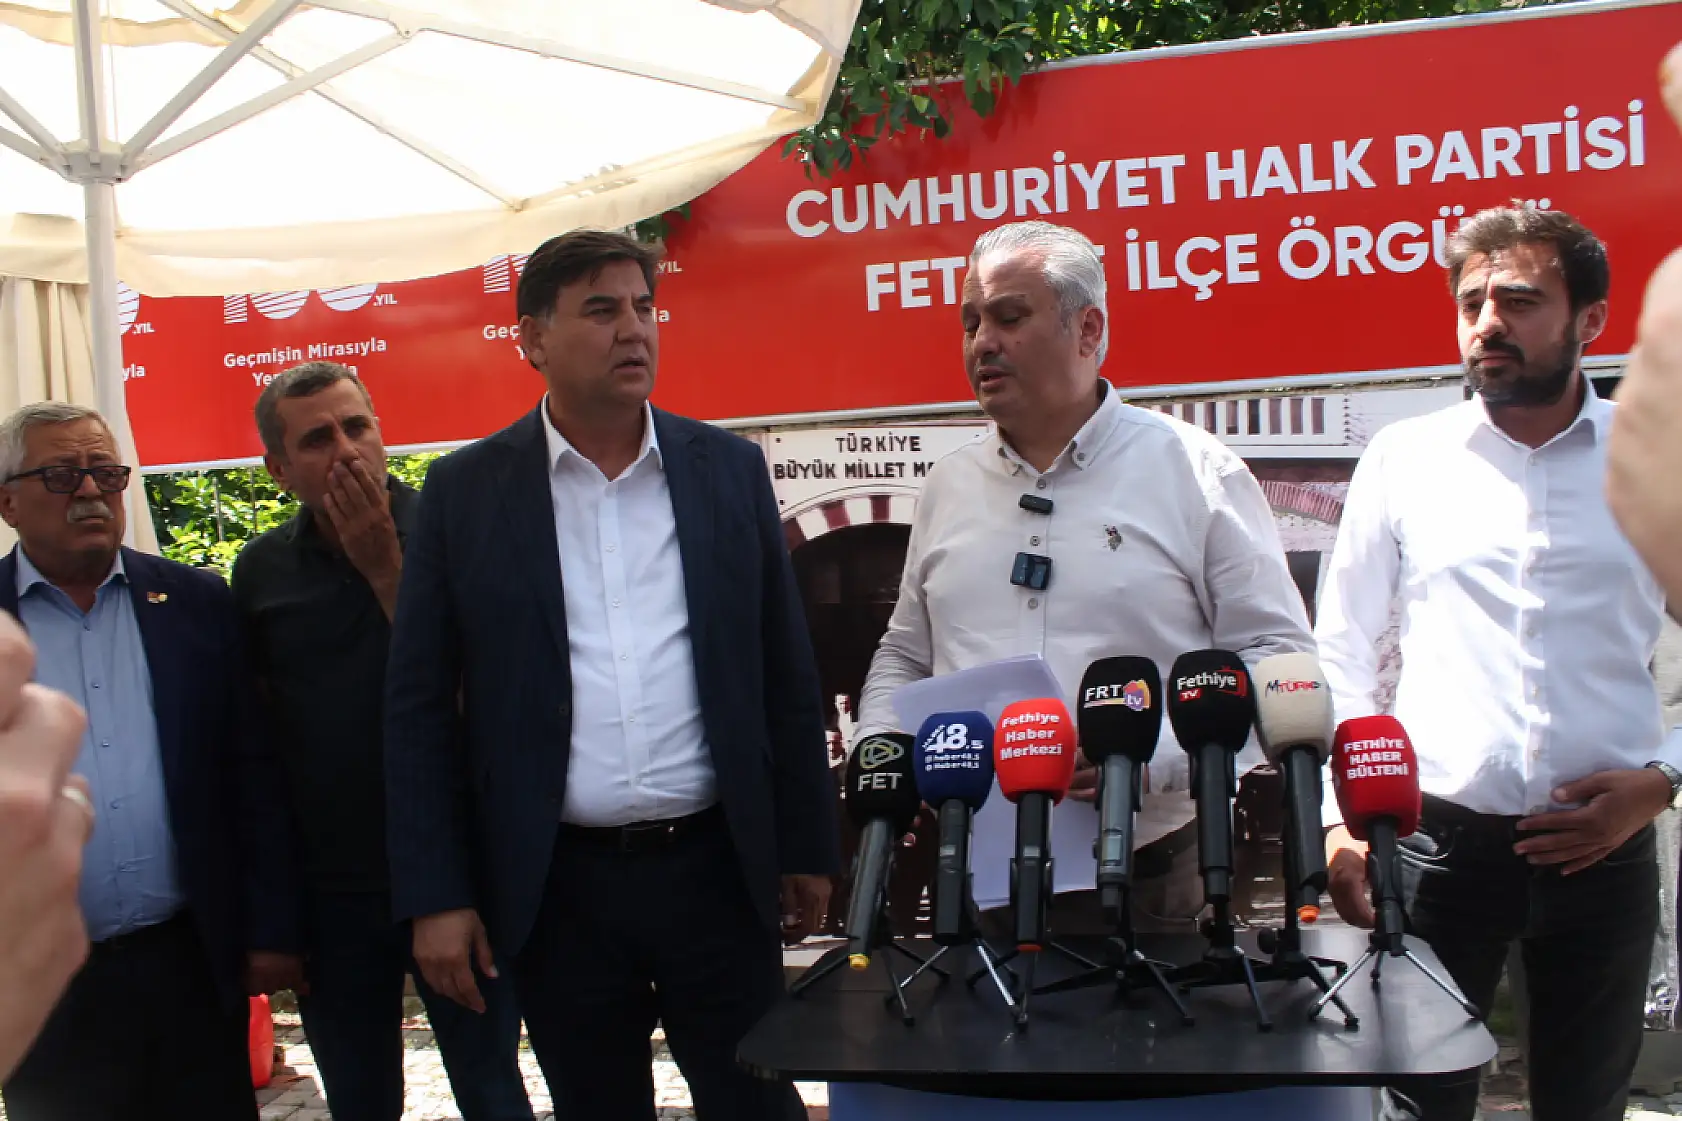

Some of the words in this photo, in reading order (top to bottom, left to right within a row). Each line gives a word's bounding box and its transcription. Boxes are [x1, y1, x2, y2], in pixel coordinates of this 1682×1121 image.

[786, 150, 1185, 238] CUMHURİYET
[1205, 137, 1377, 200] HALK
[1395, 99, 1645, 186] PARTİSİ
[1125, 228, 1260, 301] İLÇE
[223, 346, 302, 369] Geçmişin
[308, 336, 387, 359] Mirasıyla
[835, 431, 922, 453] TÜRKİYE
[773, 459, 837, 480] BÜYÜK
[844, 458, 906, 479] MİLLET
[1176, 671, 1237, 690] Fethiye
[1085, 684, 1122, 701] FRT
[1181, 689, 1199, 699] TV
[1002, 712, 1060, 728] Fethiye
[1005, 728, 1056, 743] Haber
[1000, 743, 1062, 761] Merkezi
[1343, 737, 1405, 753] FETHİYE
[1350, 751, 1402, 765] HABER
[1346, 763, 1409, 780] BÜLTENİ
[857, 772, 903, 791] FET
